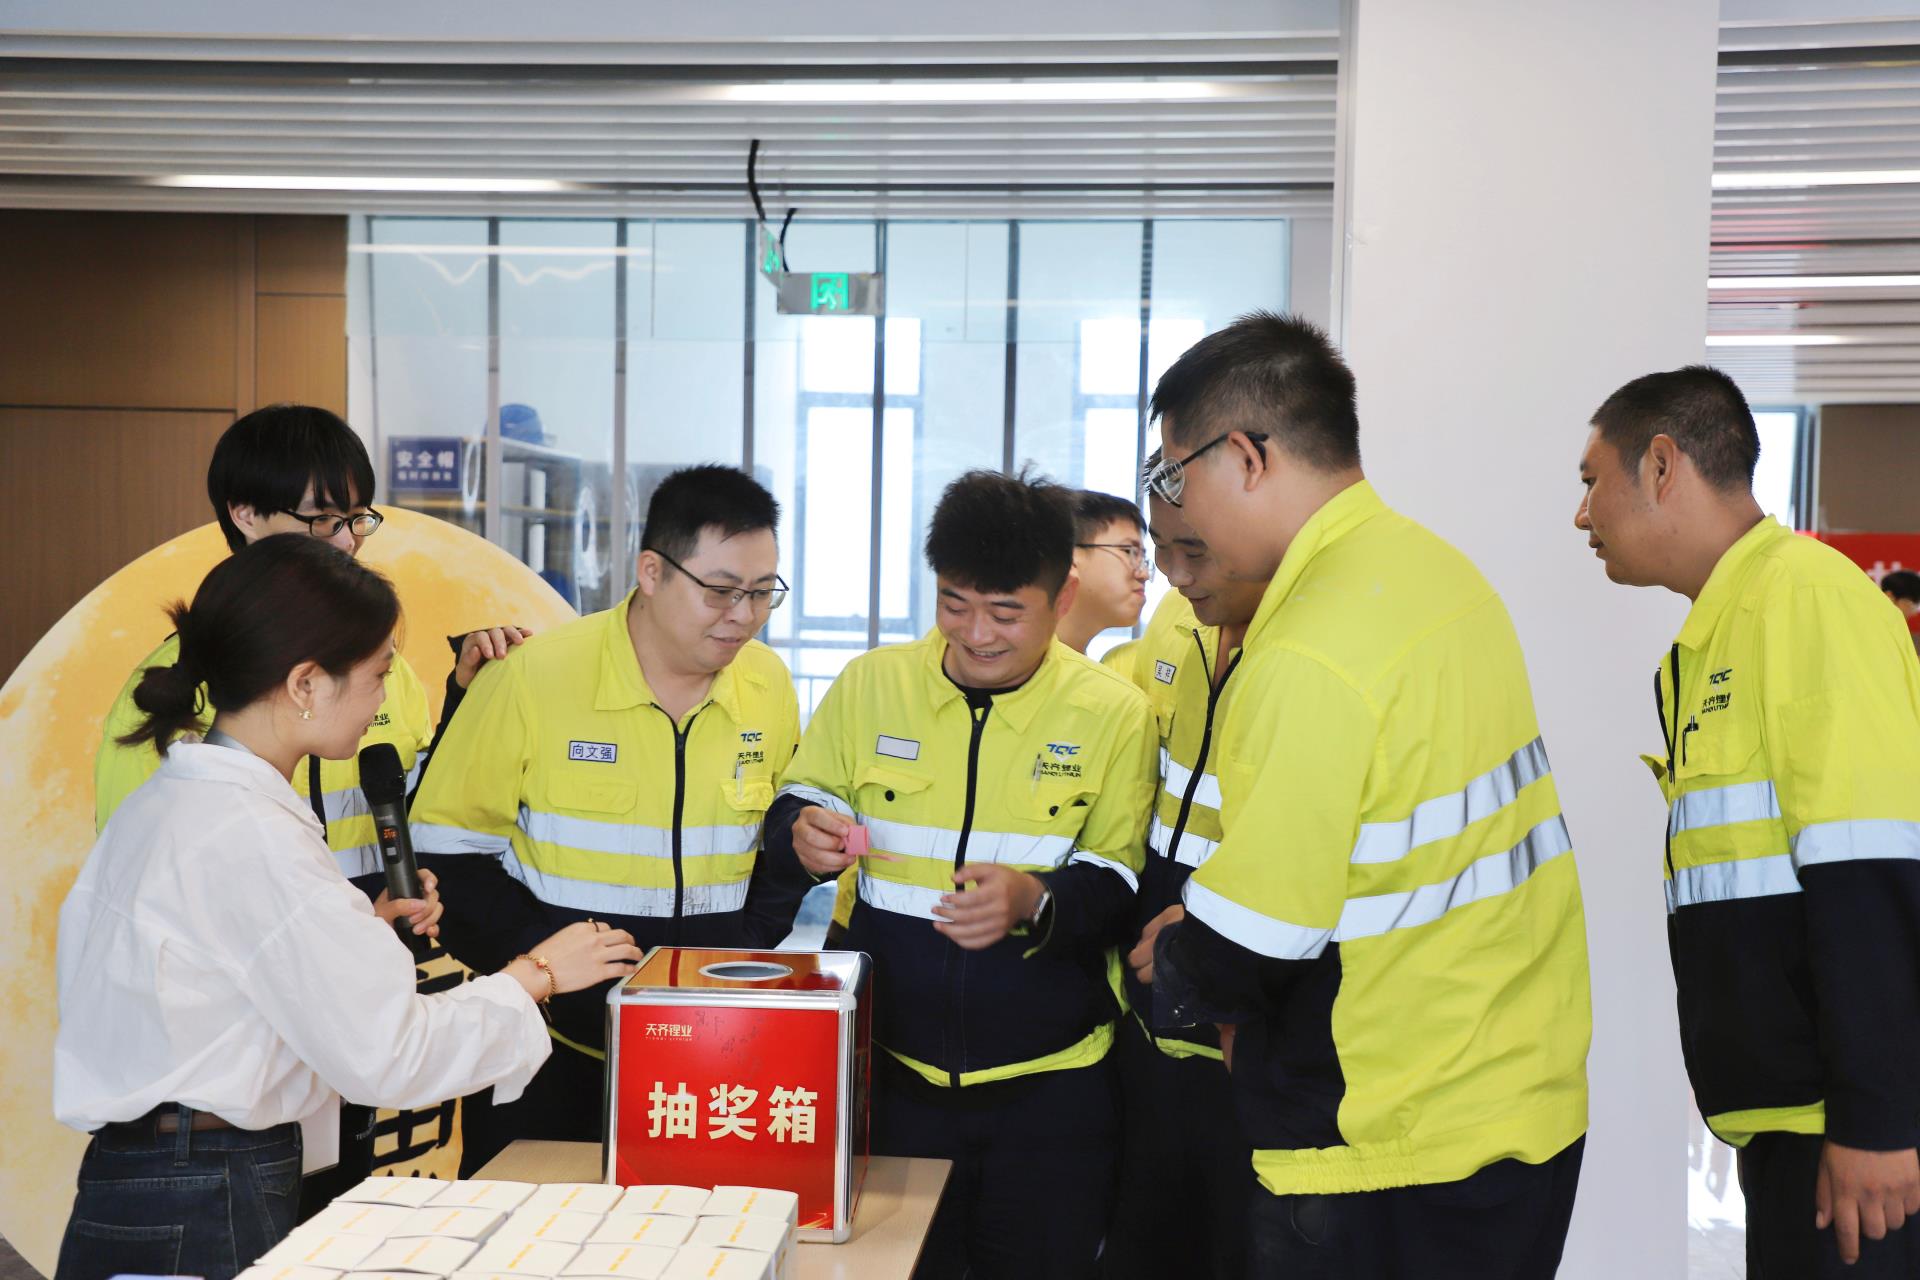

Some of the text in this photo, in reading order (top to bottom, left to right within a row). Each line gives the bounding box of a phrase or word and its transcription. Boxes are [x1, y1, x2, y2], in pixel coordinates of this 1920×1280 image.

[396, 450, 455, 469] 安全帽
[572, 743, 613, 761] 向文强
[646, 1023, 692, 1037] 天齐锂业
[648, 1081, 818, 1144] 抽奖箱
